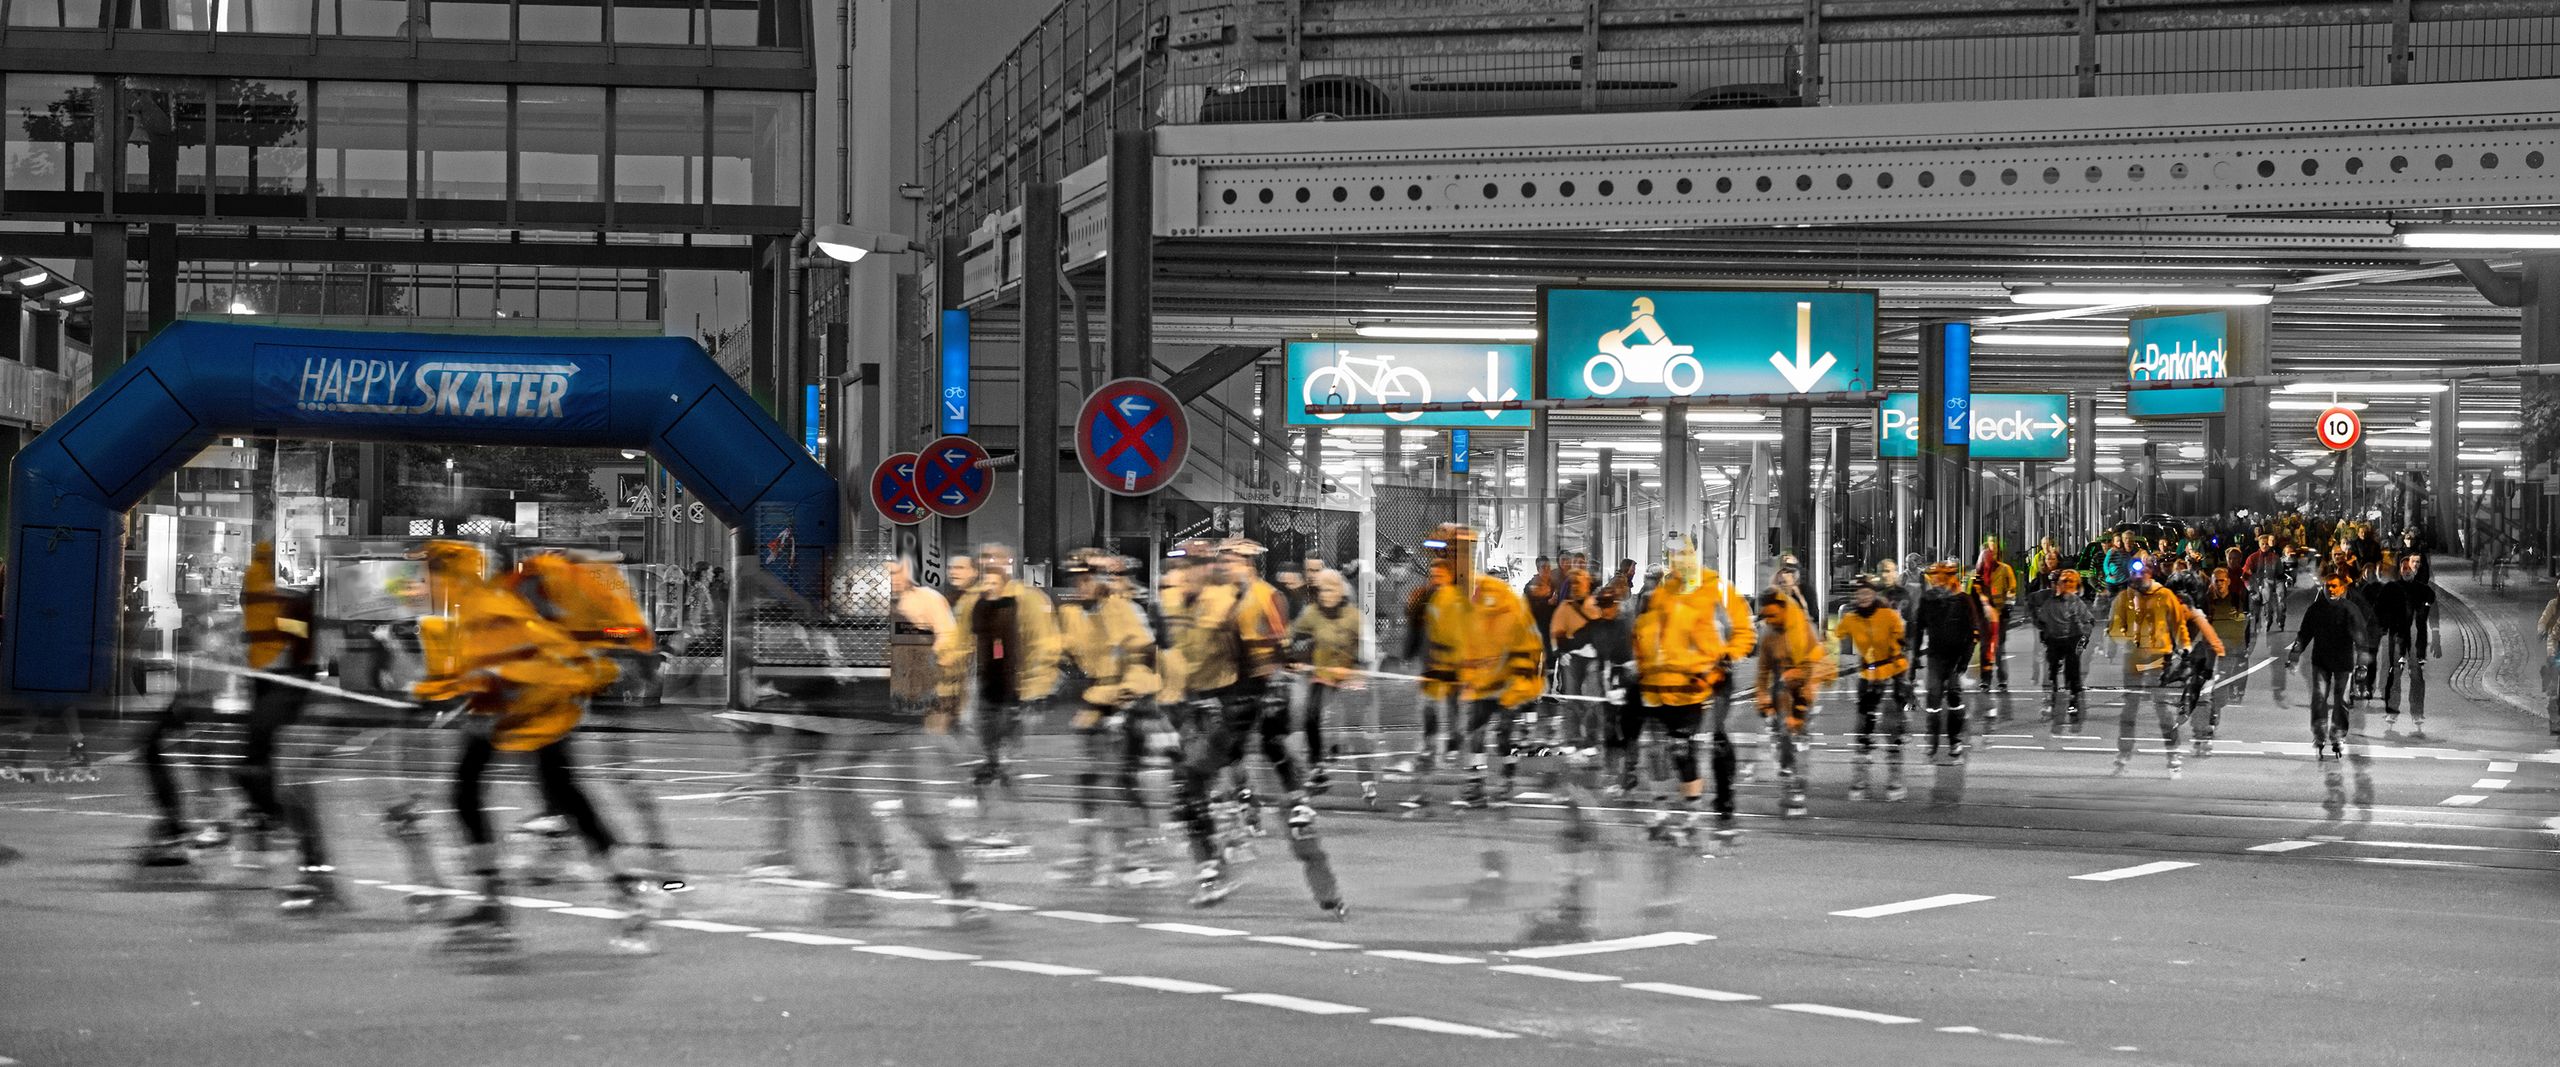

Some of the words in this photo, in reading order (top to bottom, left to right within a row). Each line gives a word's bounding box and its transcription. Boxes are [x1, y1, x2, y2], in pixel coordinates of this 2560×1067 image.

[2145, 337, 2228, 381] Parkdeck
[299, 357, 408, 404] HAPPY
[415, 361, 570, 418] SKATER
[1882, 409, 2034, 441] Paeck
[2329, 420, 2348, 436] 10
[335, 516, 346, 527] 72
